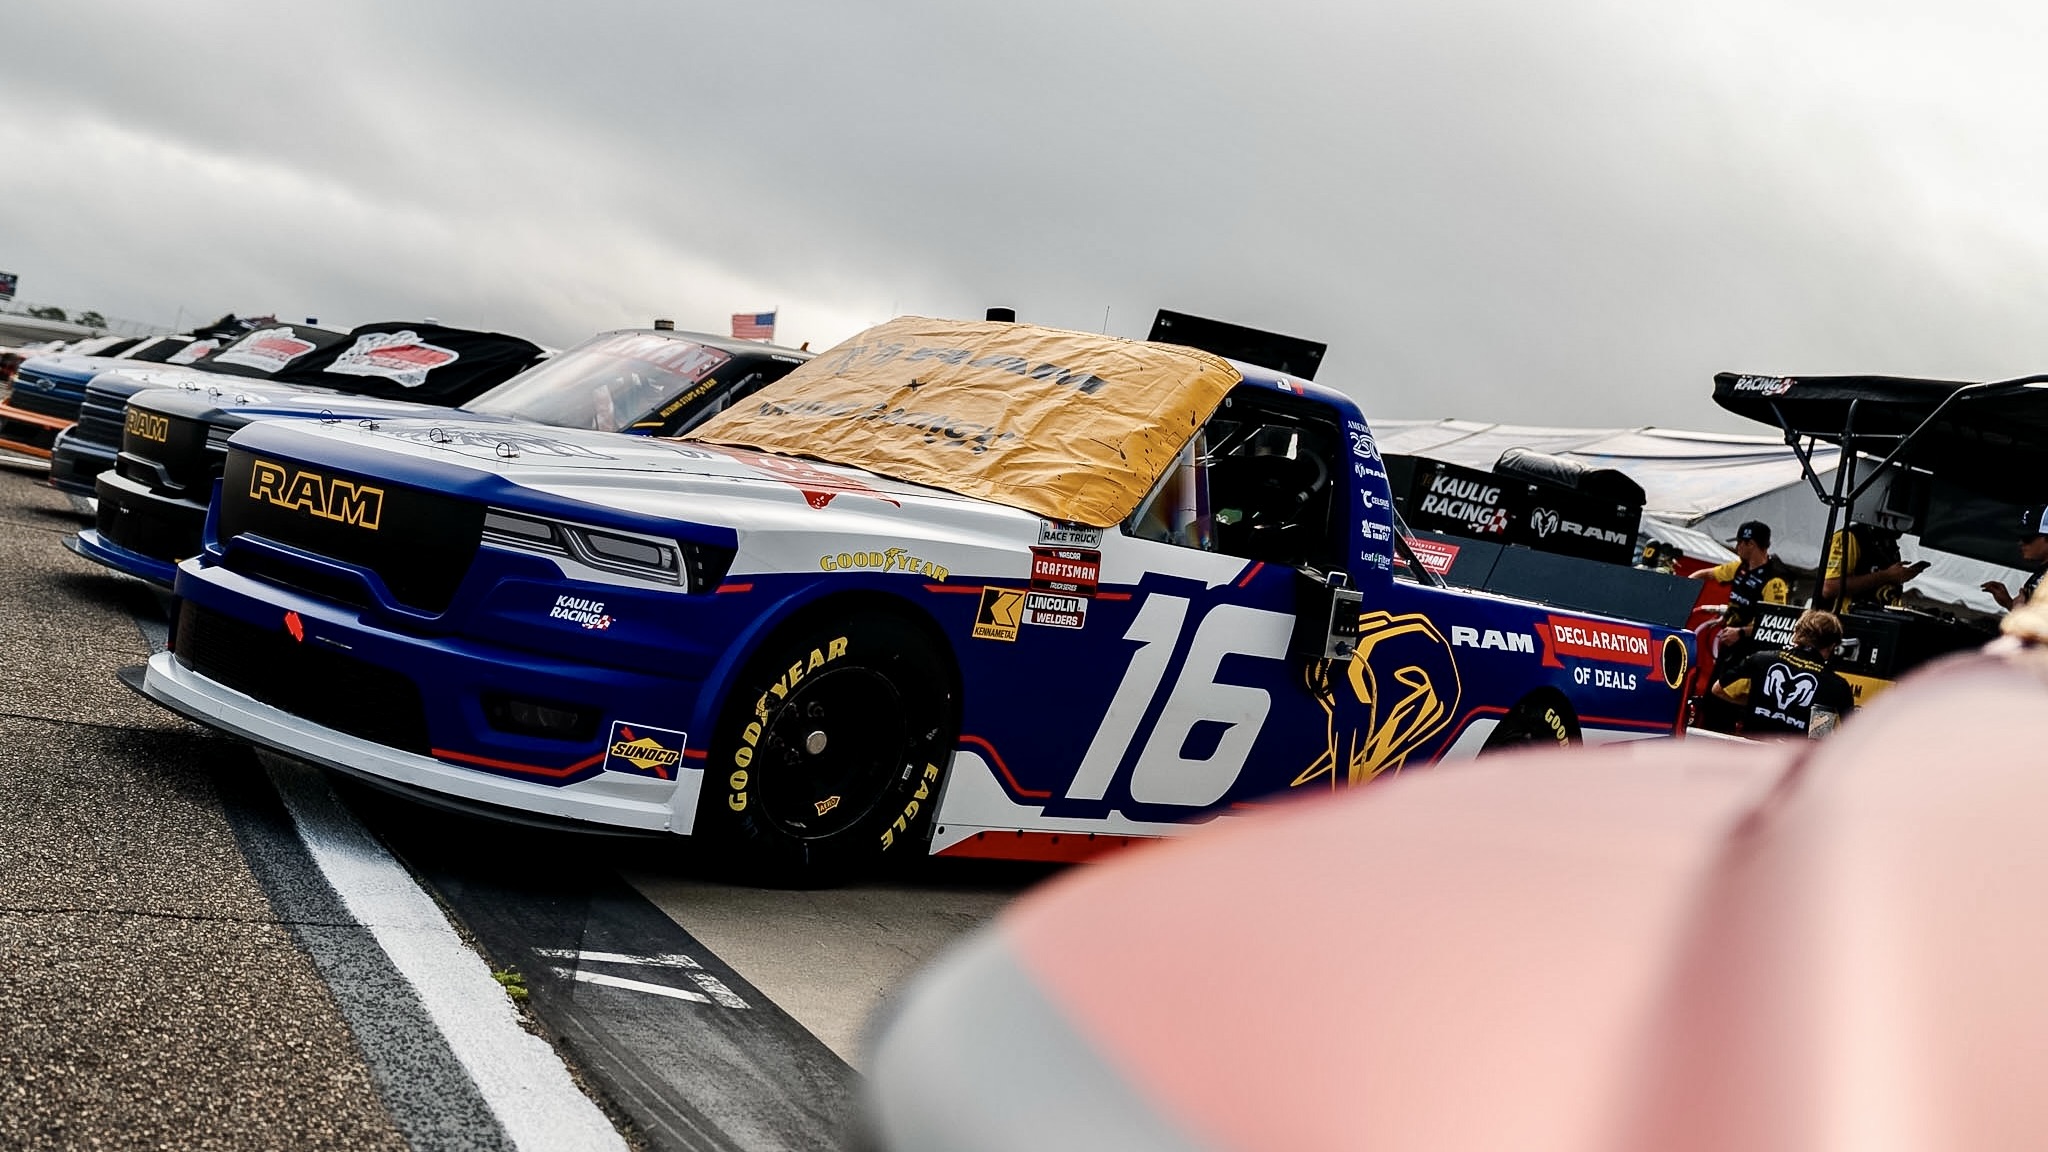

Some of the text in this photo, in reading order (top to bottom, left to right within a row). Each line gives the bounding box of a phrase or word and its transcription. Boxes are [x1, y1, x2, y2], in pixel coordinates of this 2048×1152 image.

[1734, 377, 1781, 391] RACING
[126, 408, 169, 443] RAM
[250, 459, 385, 531] RAM
[1430, 475, 1501, 504] KAULIG
[1420, 494, 1494, 525] RACING
[1043, 531, 1097, 544] RACE TRUCK
[1560, 520, 1628, 546] RAM
[820, 550, 950, 582] GOODYEAR
[1059, 551, 1081, 560] NASCAR
[1035, 561, 1096, 581] CRAFTSMAN
[549, 606, 601, 625] RACING
[555, 594, 605, 614] KAULIG
[1028, 596, 1077, 613] LINCOLN
[1036, 612, 1078, 626] WELDERS
[1760, 614, 1796, 630] KAULI
[974, 626, 1016, 640] KENNAMETAL
[1451, 625, 1535, 654] RAM
[1554, 624, 1649, 655] DECLARATION
[1574, 666, 1637, 691] OF DEALS
[1065, 592, 1297, 807] 16
[728, 636, 848, 812] GOODYEAR
[1754, 706, 1806, 730] RAM
[613, 743, 679, 764] SUNOCO
[880, 762, 939, 851] EAGLE
